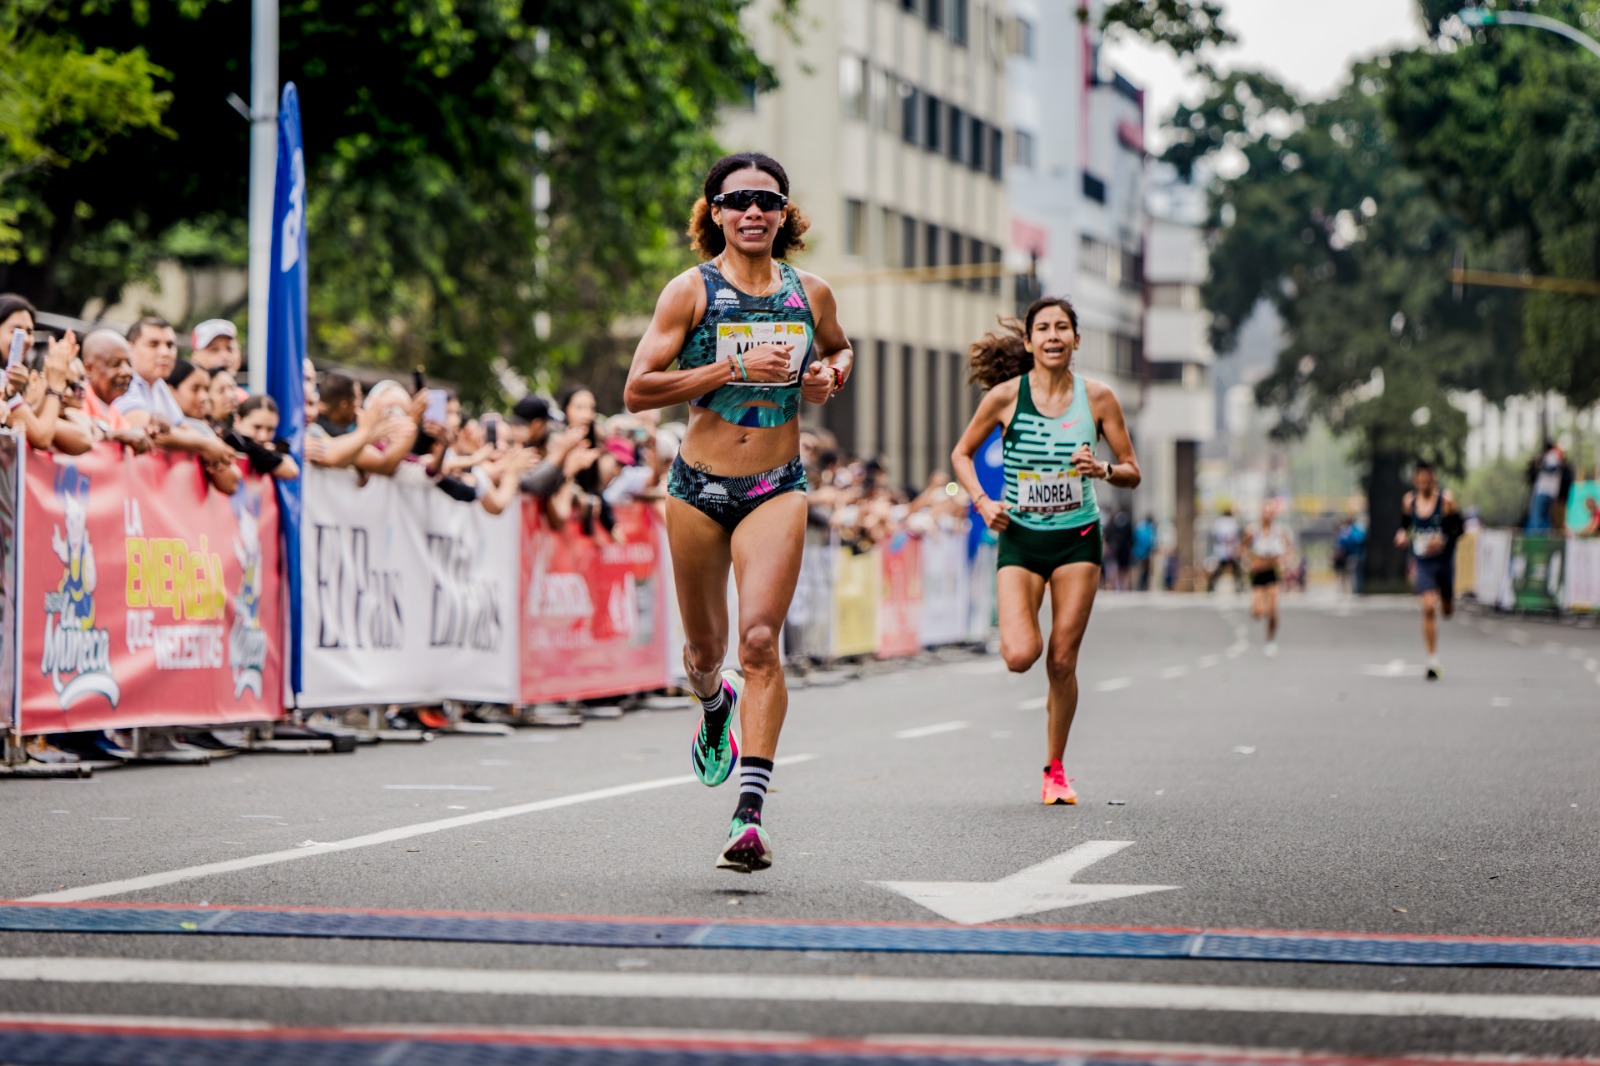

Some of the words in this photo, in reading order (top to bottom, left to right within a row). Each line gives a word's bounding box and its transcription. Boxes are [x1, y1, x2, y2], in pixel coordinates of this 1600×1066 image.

[1028, 483, 1073, 503] ANDREA
[123, 496, 144, 537] LA
[126, 609, 155, 655] QUE
